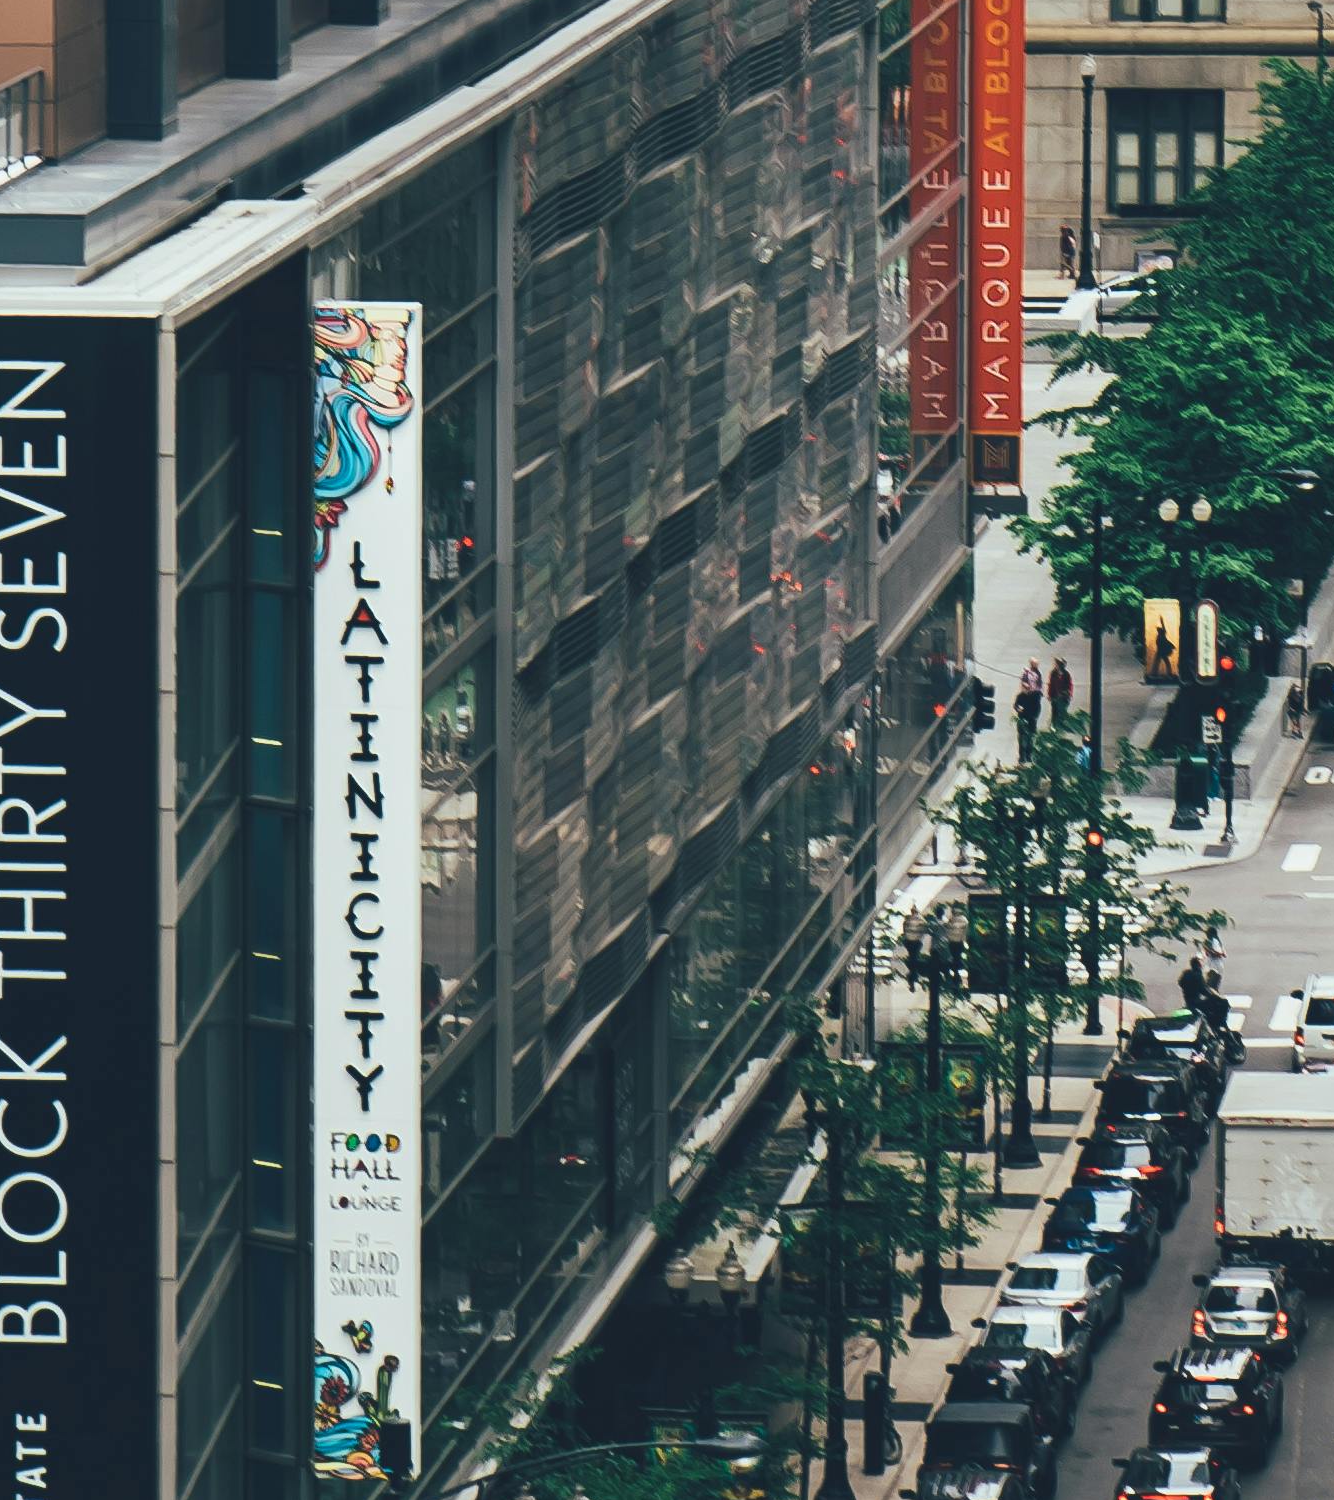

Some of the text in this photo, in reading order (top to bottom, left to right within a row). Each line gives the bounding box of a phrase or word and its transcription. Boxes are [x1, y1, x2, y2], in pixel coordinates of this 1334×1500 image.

[984, 107, 1011, 157] AT
[981, 168, 1011, 421] MARQUEE
[340, 541, 390, 1113] LATINICITY
[330, 1132, 401, 1153] FOOD
[330, 1158, 401, 1181] HALL
[329, 1195, 402, 1212] LOUNGE
[329, 1249, 400, 1275] RICHARD
[329, 1276, 400, 1298] SANDOVAL
